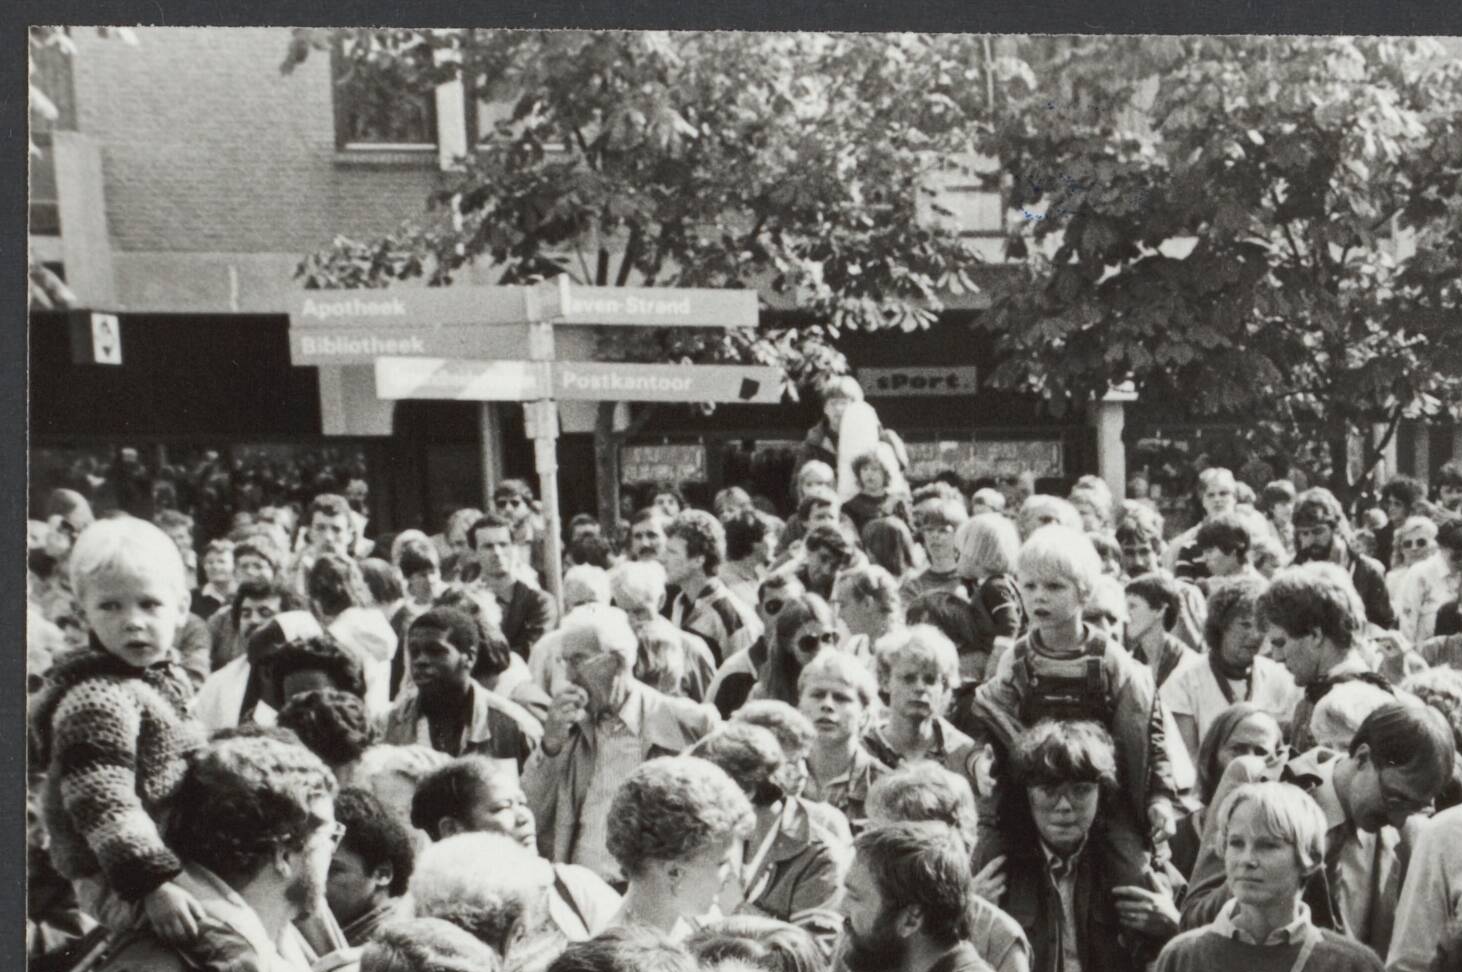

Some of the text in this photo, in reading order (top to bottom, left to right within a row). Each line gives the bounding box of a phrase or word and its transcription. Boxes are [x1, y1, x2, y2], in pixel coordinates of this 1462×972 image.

[302, 298, 406, 321] Apotheek
[302, 336, 424, 354] Bibliotheek
[562, 371, 693, 392] Postkantoor
